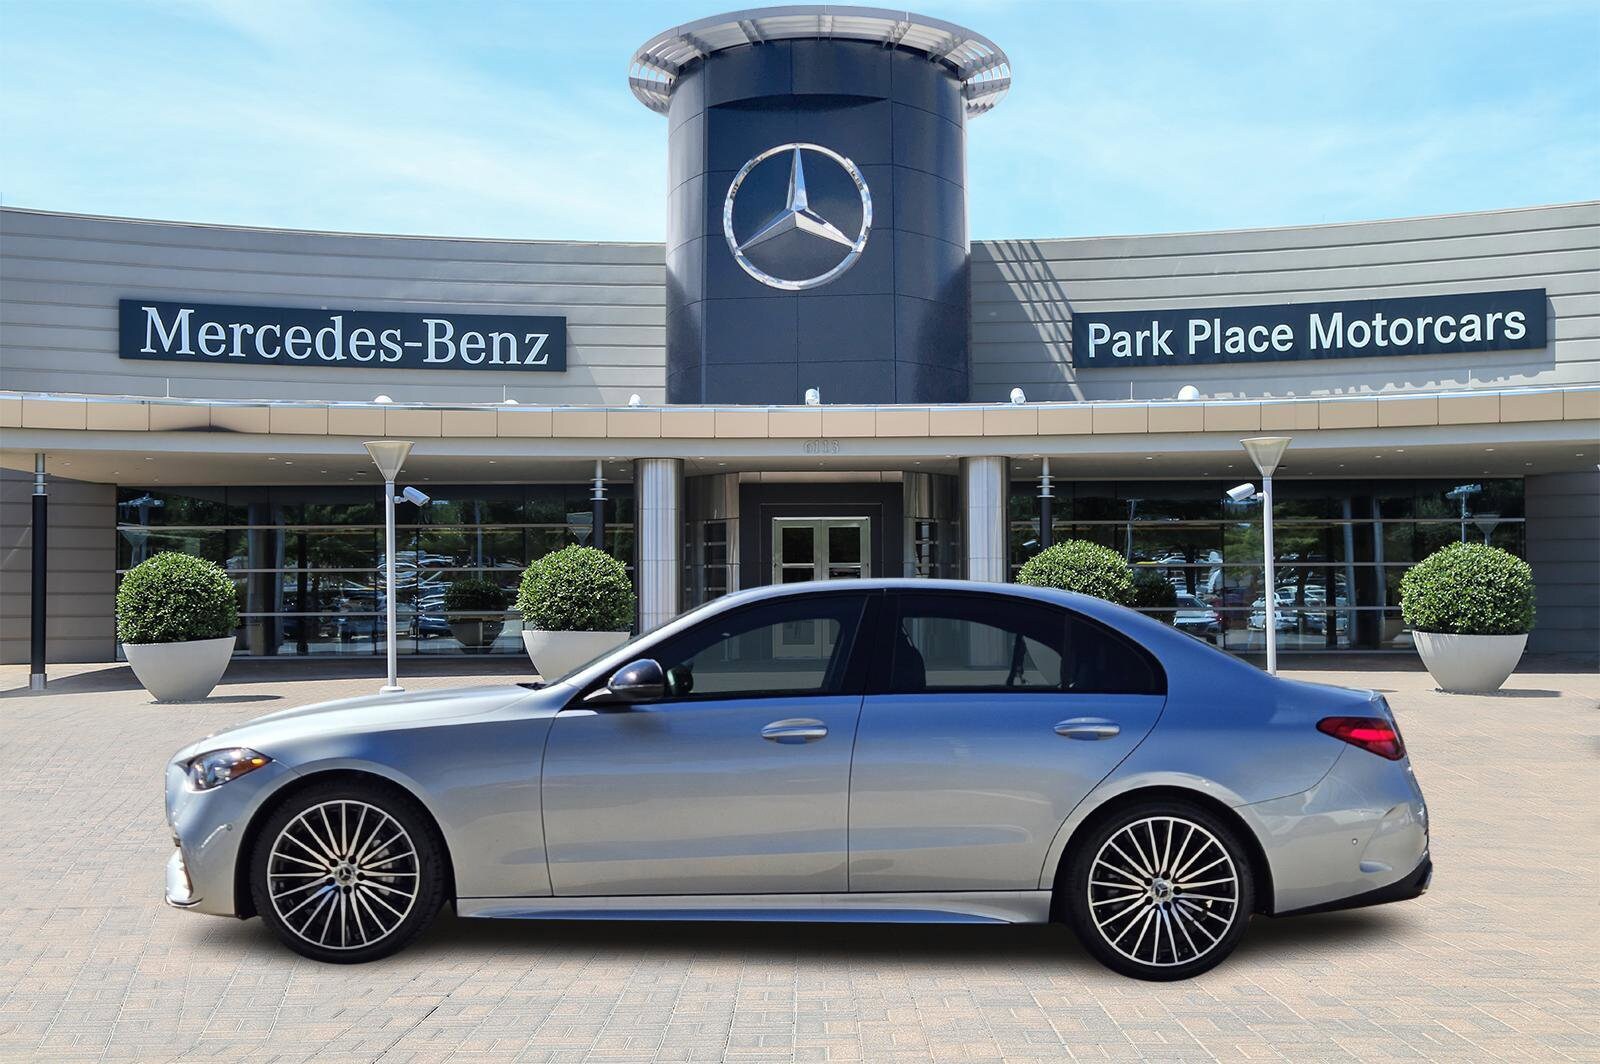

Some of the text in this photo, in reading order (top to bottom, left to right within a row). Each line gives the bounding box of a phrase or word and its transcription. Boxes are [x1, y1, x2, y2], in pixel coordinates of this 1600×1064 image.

[140, 306, 549, 365] Mercedes-Benz
[1088, 310, 1527, 358] Park Place Motorcars
[803, 440, 840, 454] 6113
